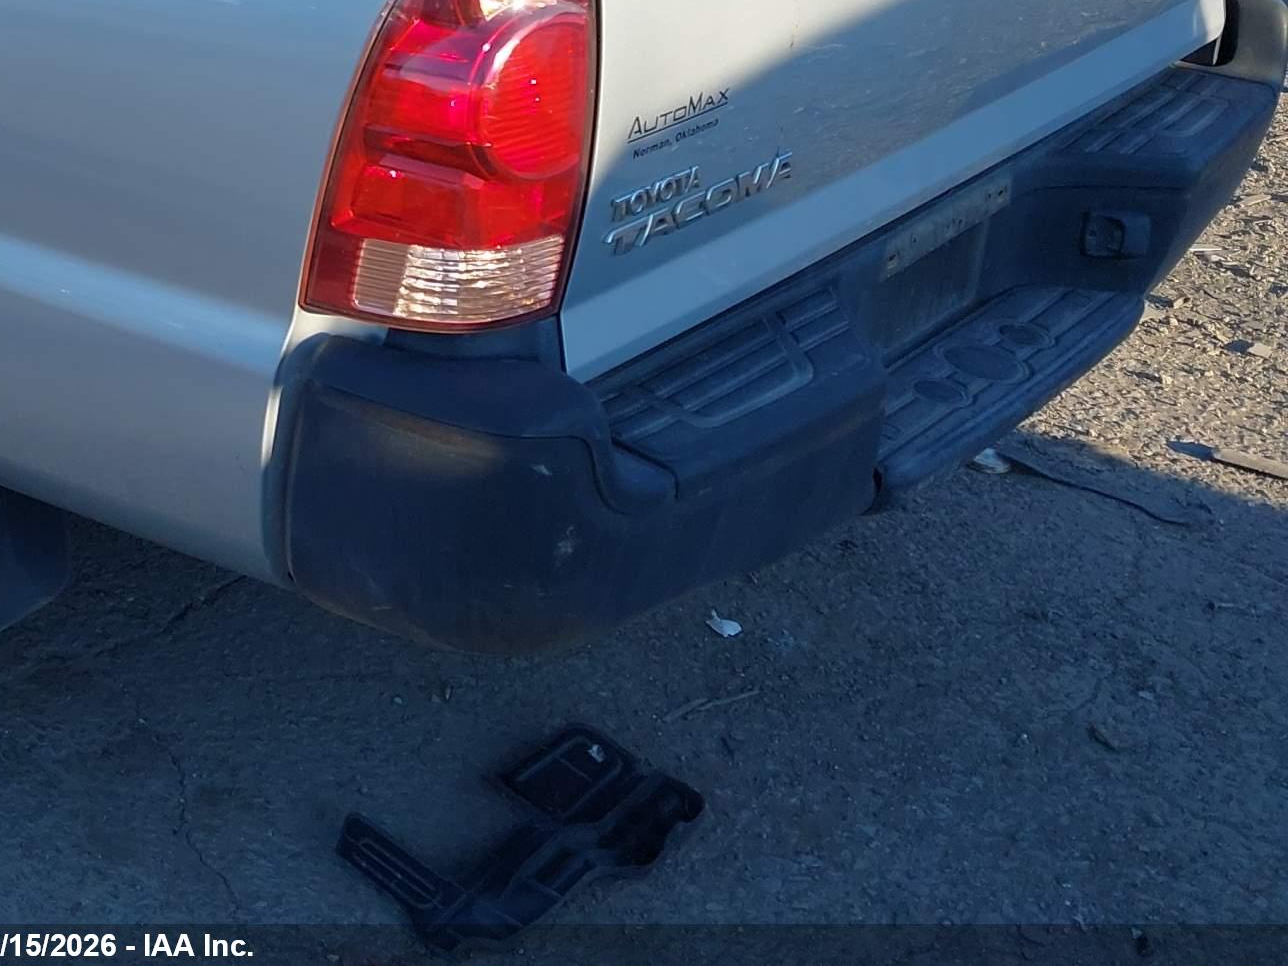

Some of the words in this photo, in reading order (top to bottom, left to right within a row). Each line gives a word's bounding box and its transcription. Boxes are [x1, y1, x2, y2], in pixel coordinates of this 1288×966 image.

[631, 138, 673, 160] Norman,
[674, 117, 720, 143] Oklahoma
[603, 147, 793, 256] TACOMA
[611, 165, 701, 222] TOYOTA
